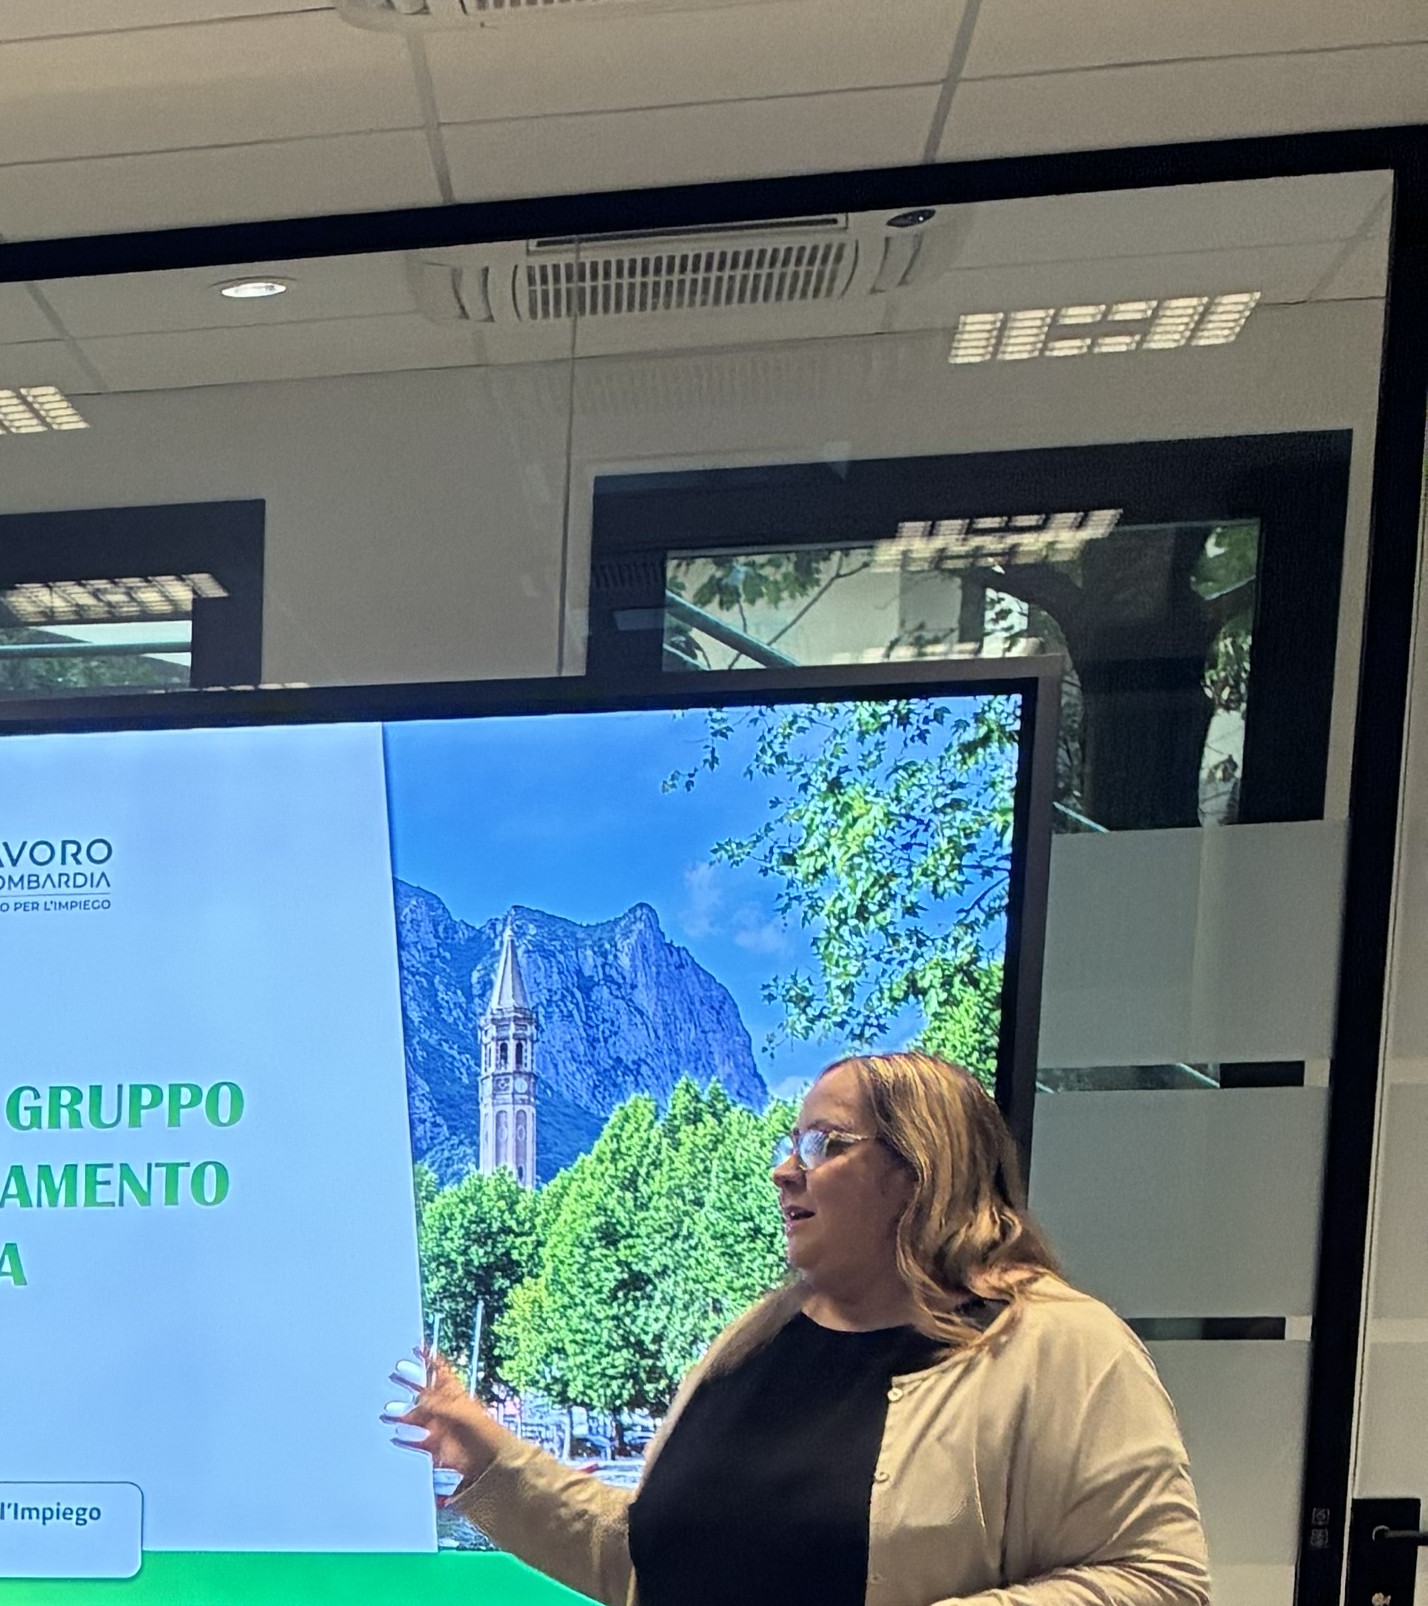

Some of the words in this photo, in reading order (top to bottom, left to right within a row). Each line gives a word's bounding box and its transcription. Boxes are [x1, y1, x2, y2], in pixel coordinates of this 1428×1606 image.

[14, 898, 41, 913] PER
[45, 897, 111, 912] L'IMPIEGO
[5, 1080, 246, 1132] GRUPPO
[0, 1502, 101, 1526] l'Impiego
